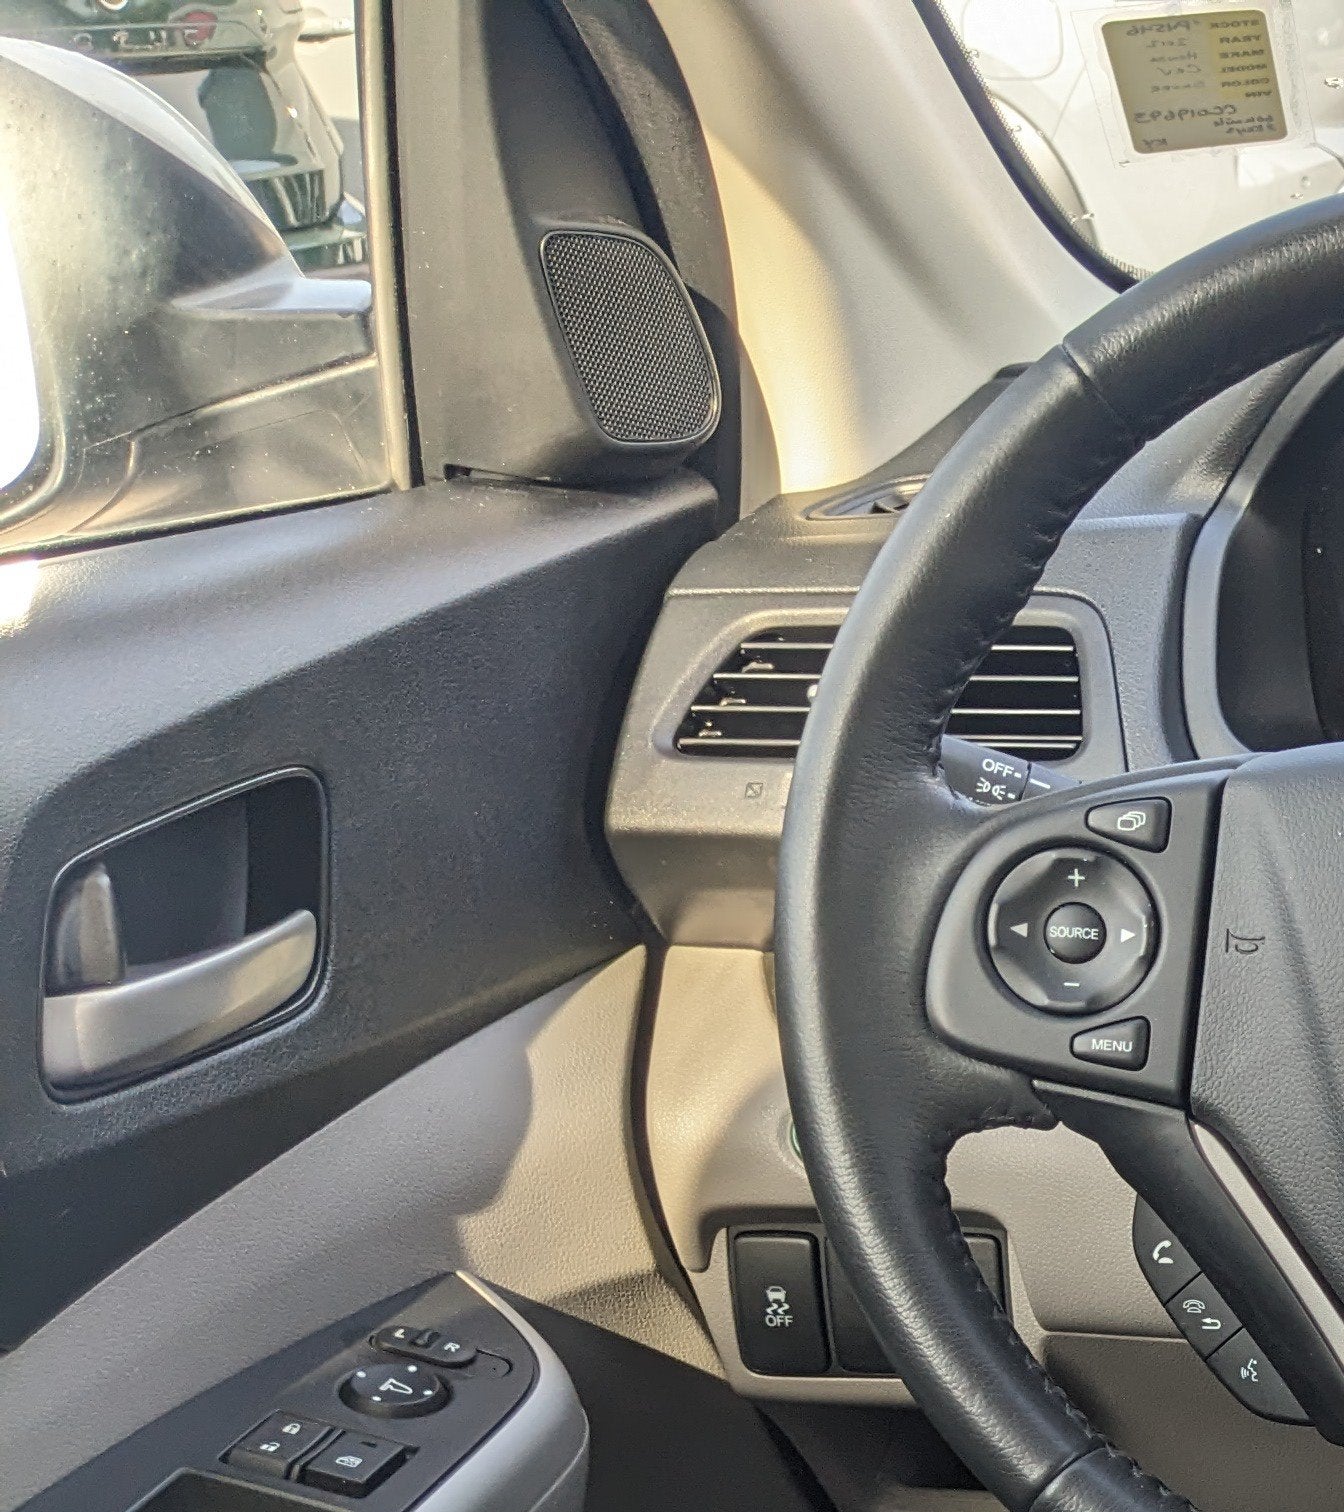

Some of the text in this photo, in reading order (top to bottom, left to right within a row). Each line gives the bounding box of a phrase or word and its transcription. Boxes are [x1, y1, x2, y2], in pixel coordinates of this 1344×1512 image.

[982, 758, 1015, 777] OFF
[1049, 926, 1100, 941] SOURCE
[1091, 1038, 1133, 1053] MENU
[765, 1314, 794, 1327] OFF
[443, 1342, 460, 1352] R
